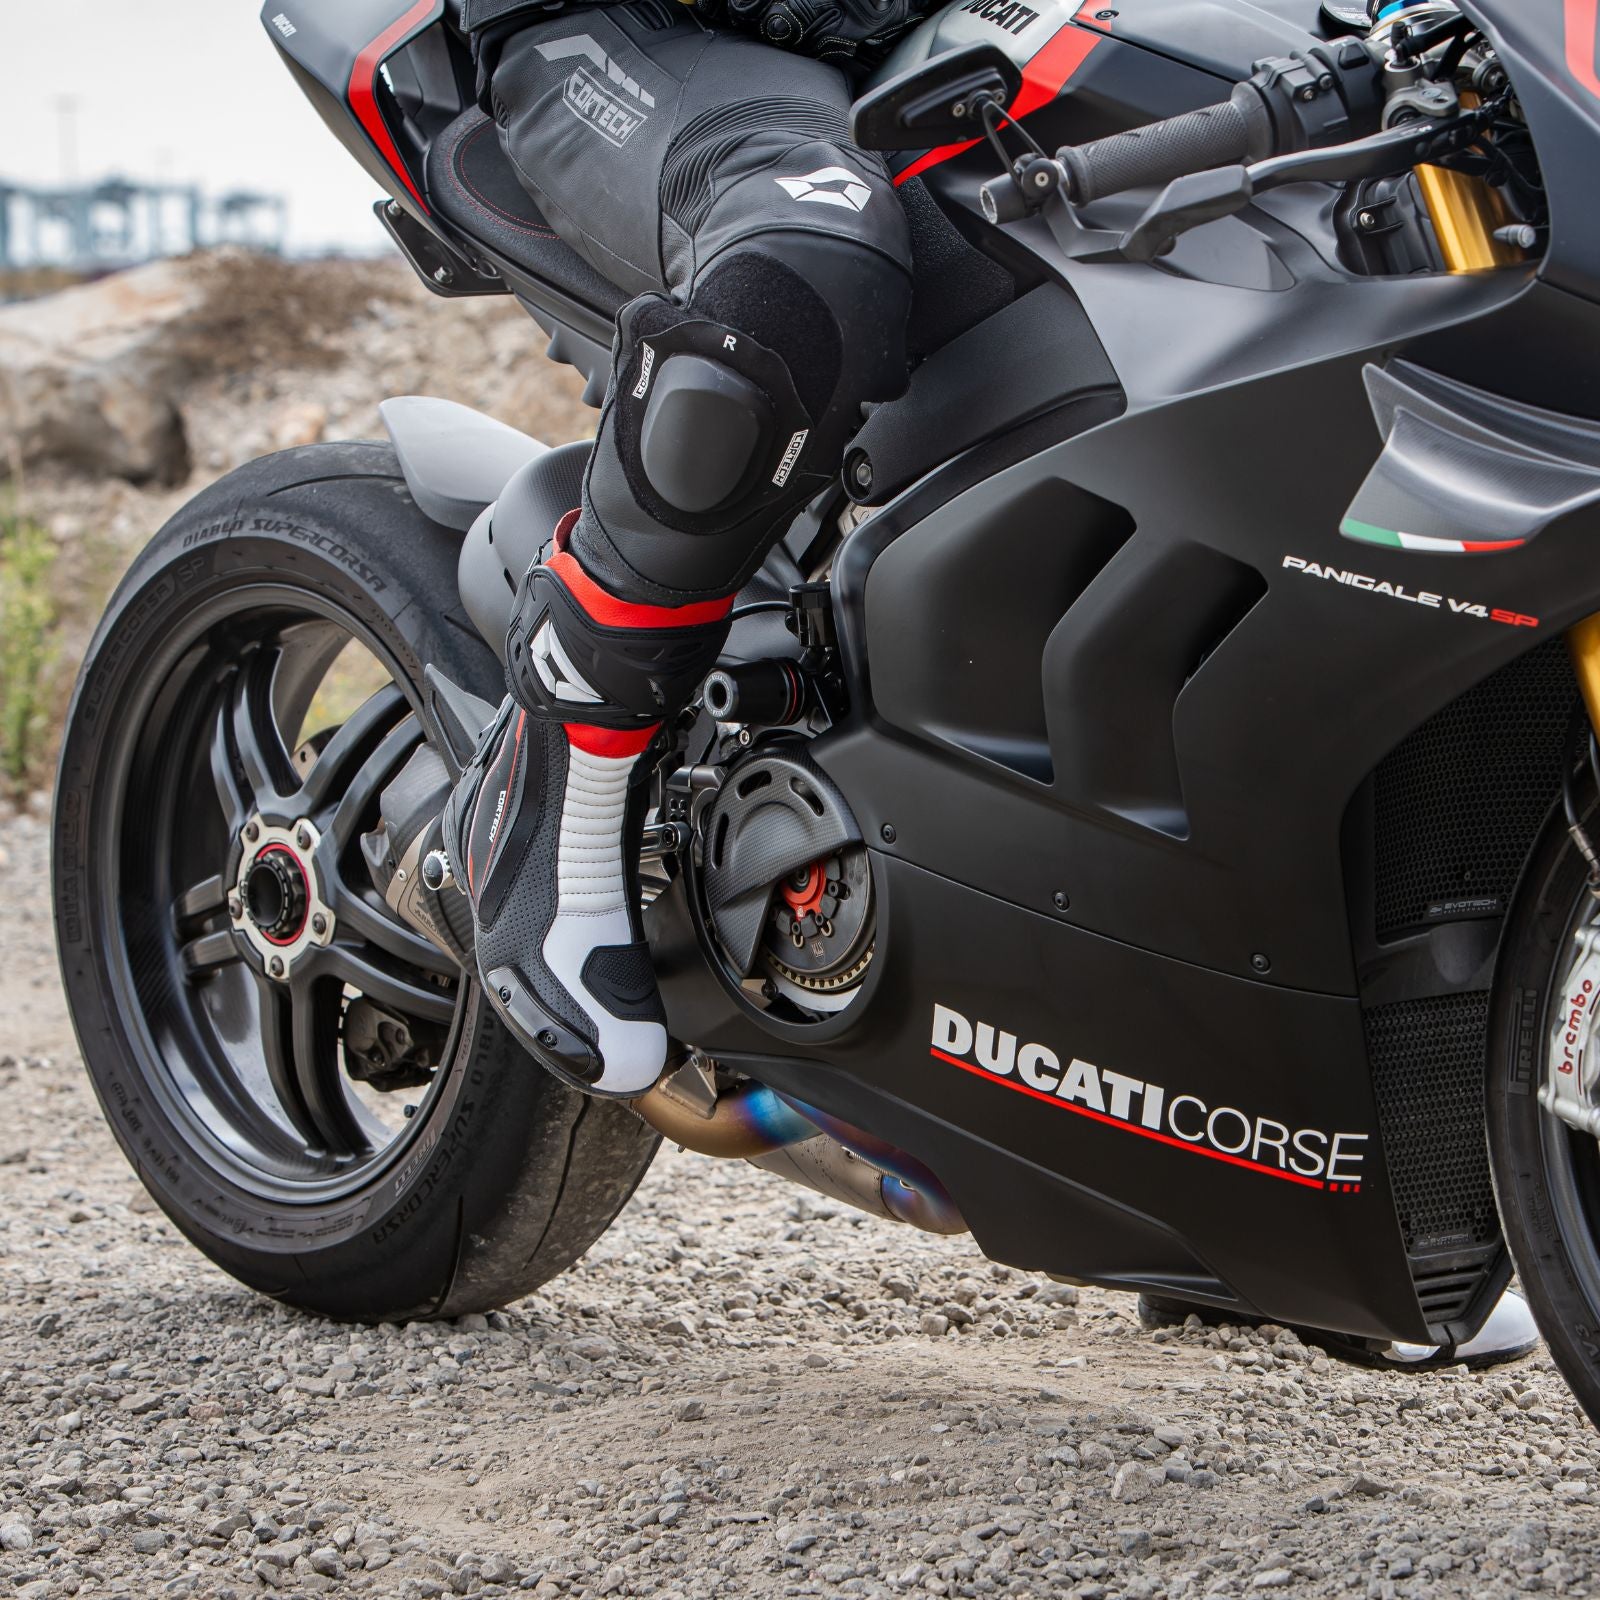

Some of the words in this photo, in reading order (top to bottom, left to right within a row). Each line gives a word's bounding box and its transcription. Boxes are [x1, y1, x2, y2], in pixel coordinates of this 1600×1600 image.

[271, 13, 297, 38] DUCATI
[567, 72, 639, 140] CORTECH
[635, 345, 655, 397] CORTECH
[722, 334, 737, 351] R
[775, 431, 807, 485] CORTECH
[182, 519, 244, 548] DIABLO
[248, 518, 388, 593] SUPERCORSA
[1282, 555, 1443, 608] PANIGALE
[84, 583, 170, 722] SUPERCORSA
[177, 556, 206, 583] SP
[488, 790, 507, 843] CORTECH
[1507, 987, 1538, 1096] PIRELLI
[1558, 979, 1593, 1075] brembo
[373, 1096, 475, 1245] SUPERCORSA
